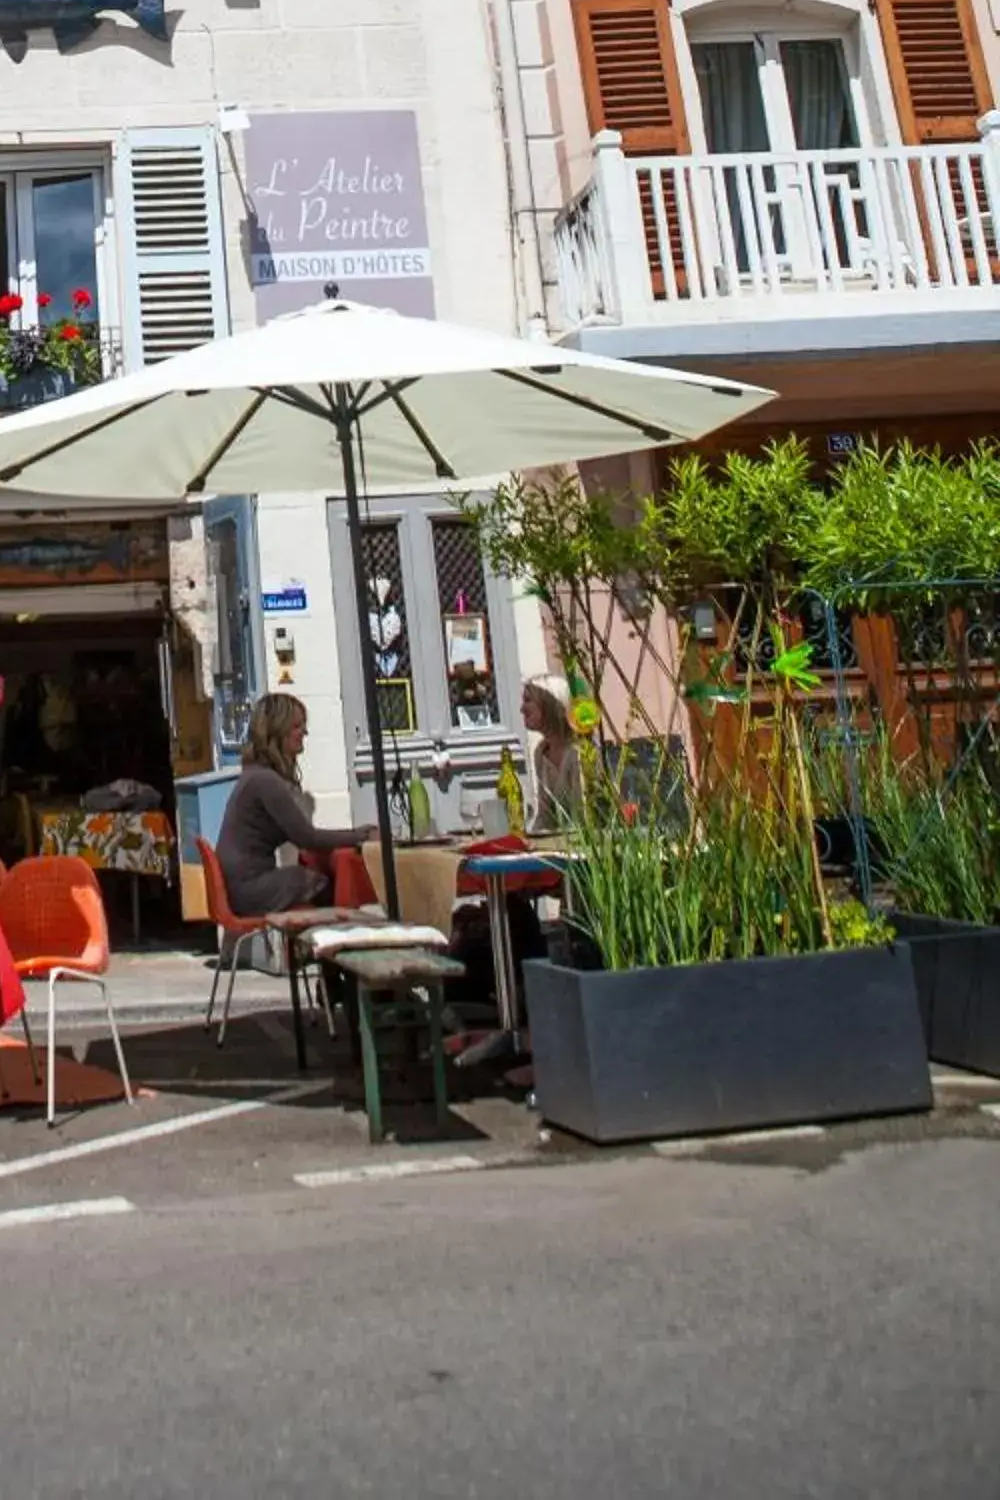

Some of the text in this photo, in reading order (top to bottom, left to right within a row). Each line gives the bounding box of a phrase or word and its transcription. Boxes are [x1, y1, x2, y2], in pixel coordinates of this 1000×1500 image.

[253, 155, 405, 196] L'Atelier
[297, 197, 411, 242] Peintre
[258, 252, 426, 278] MAISON D'HÔTES
